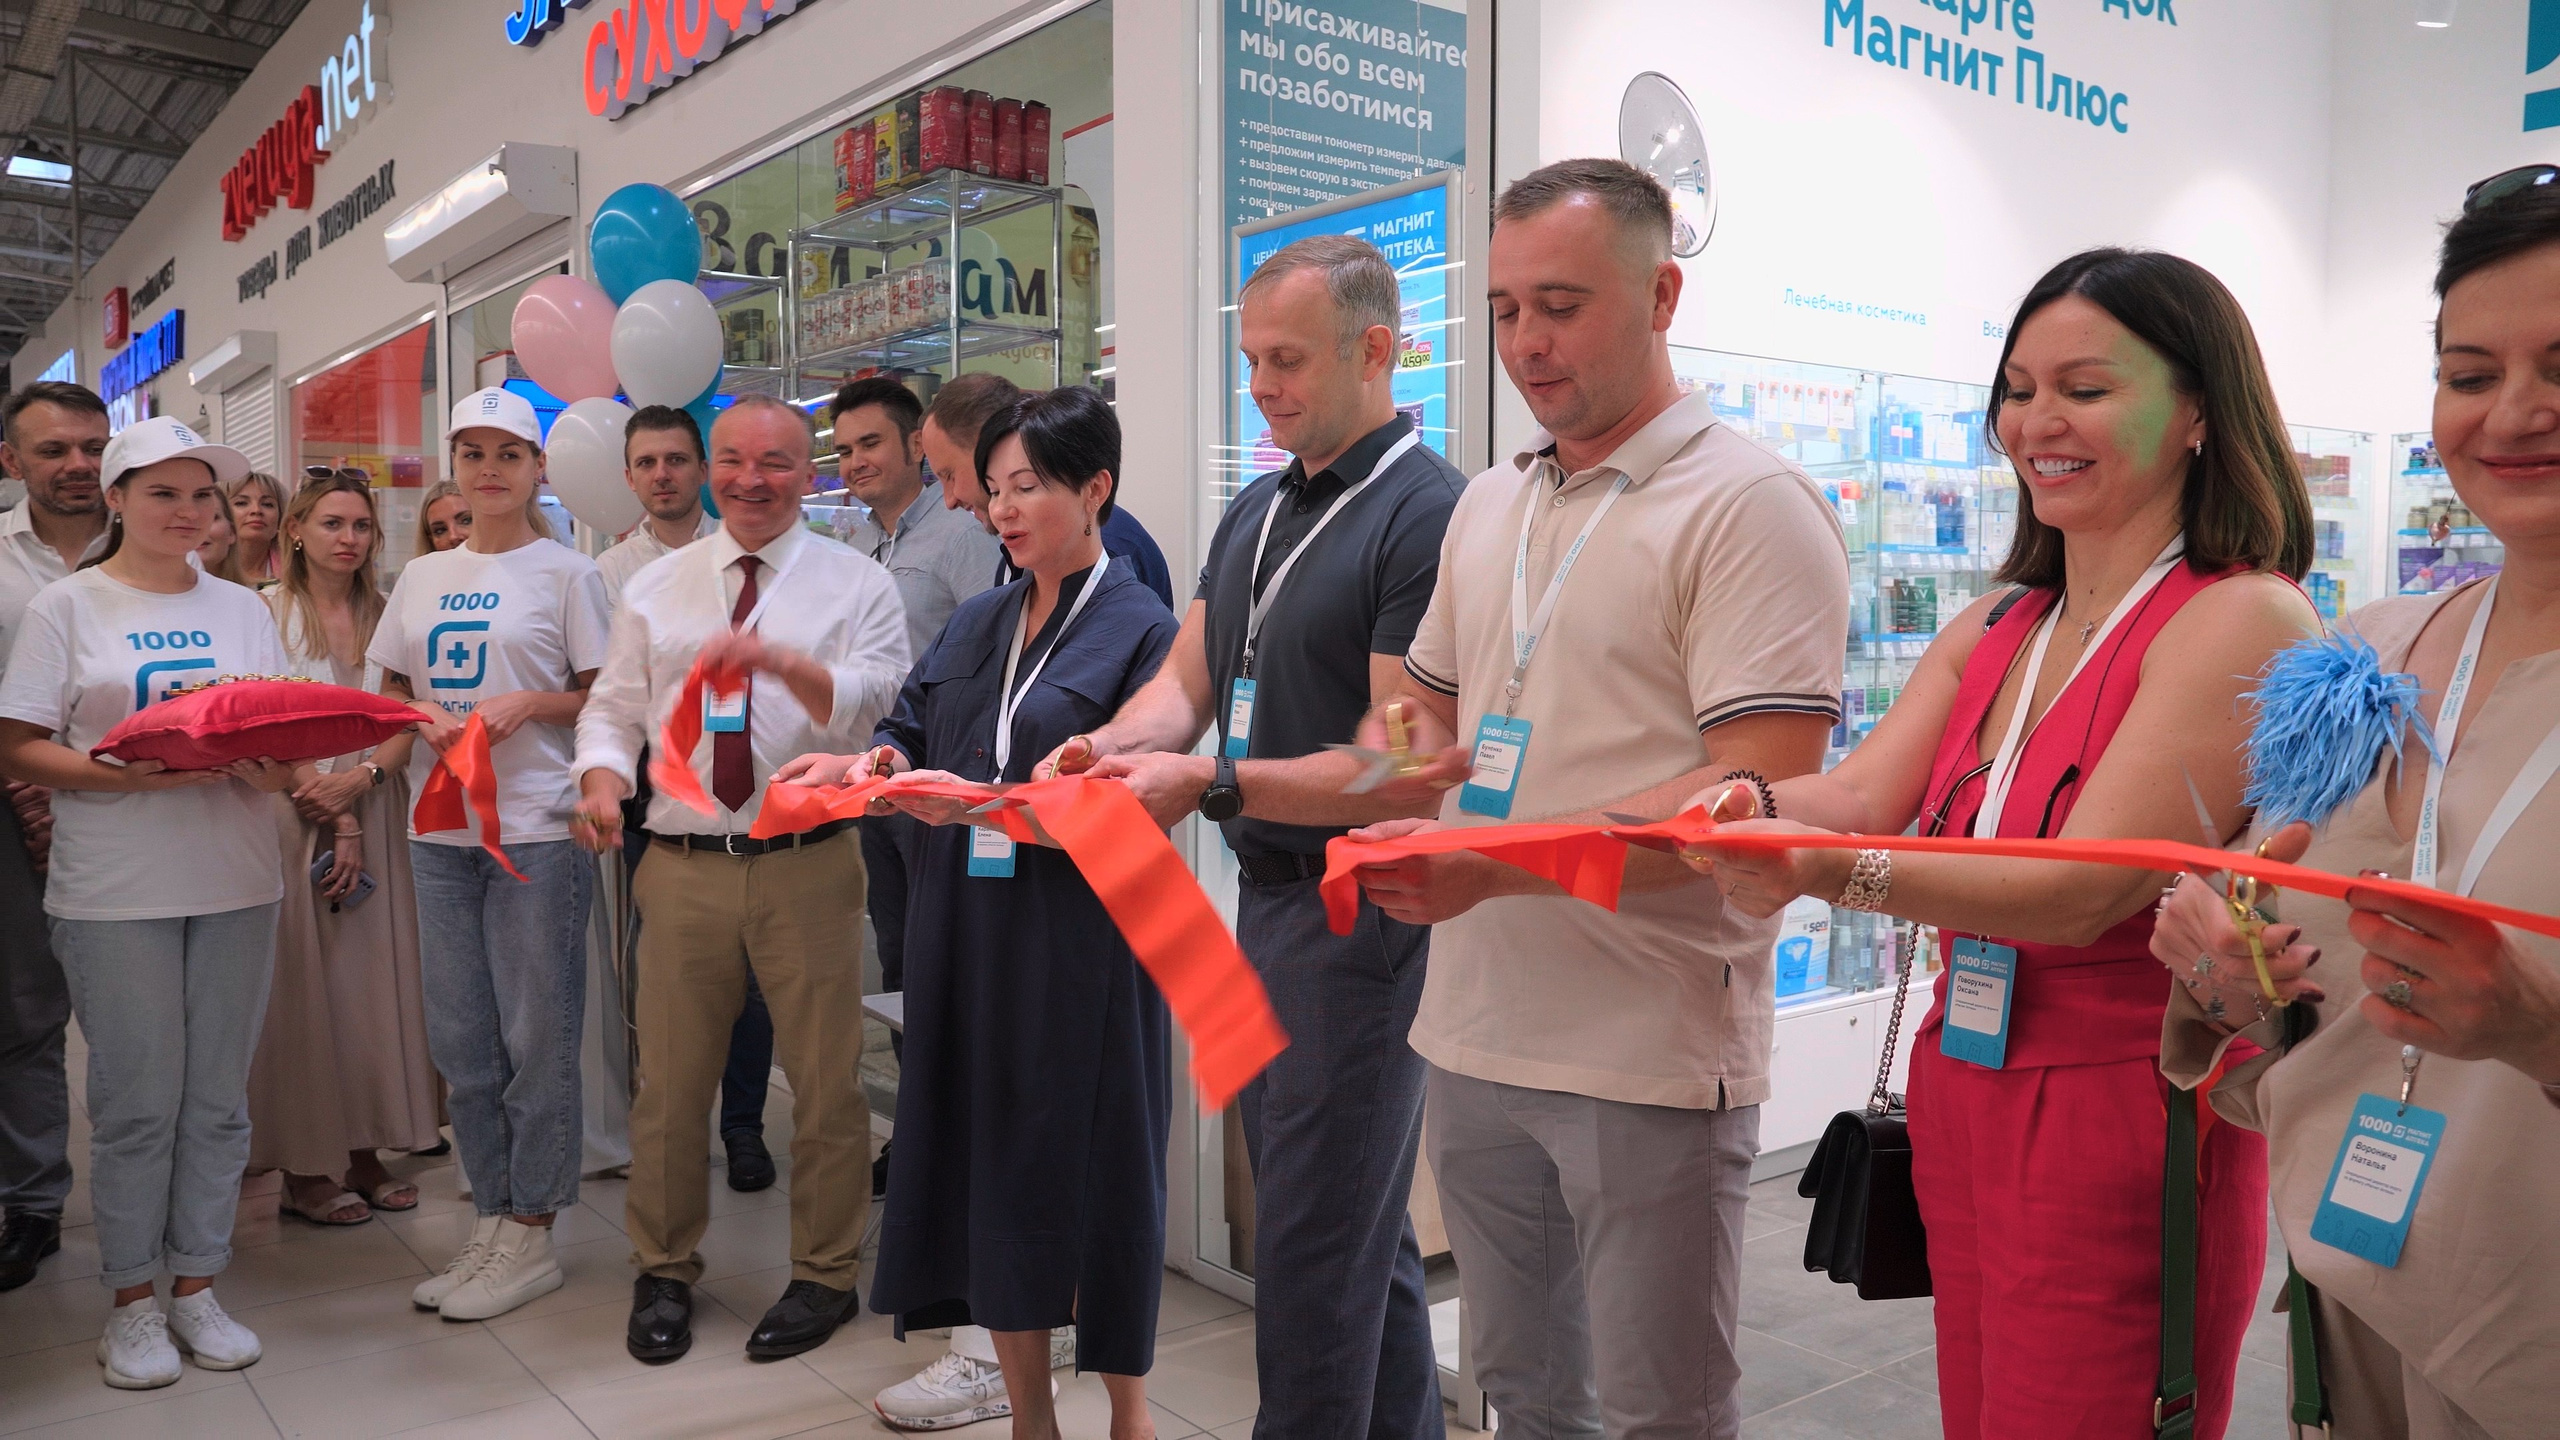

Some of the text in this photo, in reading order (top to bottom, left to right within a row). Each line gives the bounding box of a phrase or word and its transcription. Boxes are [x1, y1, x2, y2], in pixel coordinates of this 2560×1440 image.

[1240, 29, 1425, 94] мы обо всем
[1824, 0, 2128, 135] Магнит Плюс
[1240, 68, 1433, 132] позаботимся
[1249, 120, 1322, 144] предоставим
[1324, 136, 1374, 157] тонометр
[1376, 146, 1425, 165] измерить
[1249, 139, 1315, 161] предложим
[1317, 152, 1368, 172] измерить
[1369, 163, 1416, 181] темпера
[1249, 158, 1298, 176] вызовем
[1299, 168, 1340, 185] скорую
[1342, 176, 1349, 186] в
[1249, 177, 1301, 196] поможем
[1302, 187, 1347, 202] заряди
[317, 158, 396, 251] животных
[1248, 196, 1293, 213] окажем
[1373, 210, 1435, 240] МАГНИТ
[1377, 235, 1436, 260] ПТЕКА
[1783, 287, 1928, 326] Лечебная косметика
[1982, 320, 2004, 339] Всё
[1402, 354, 1422, 369] 459
[439, 592, 500, 612] 1000
[126, 630, 213, 651] 1000
[1482, 726, 1502, 737] 1000
[1809, 917, 1829, 933] seni
[1956, 954, 1980, 968] 1000
[1956, 985, 1979, 996] Оксана
[1957, 975, 1993, 990] Говорухина
[2358, 1114, 2393, 1134] 1000
[2350, 1152, 2387, 1172] Наталья
[2355, 1141, 2398, 1162] Воронина
